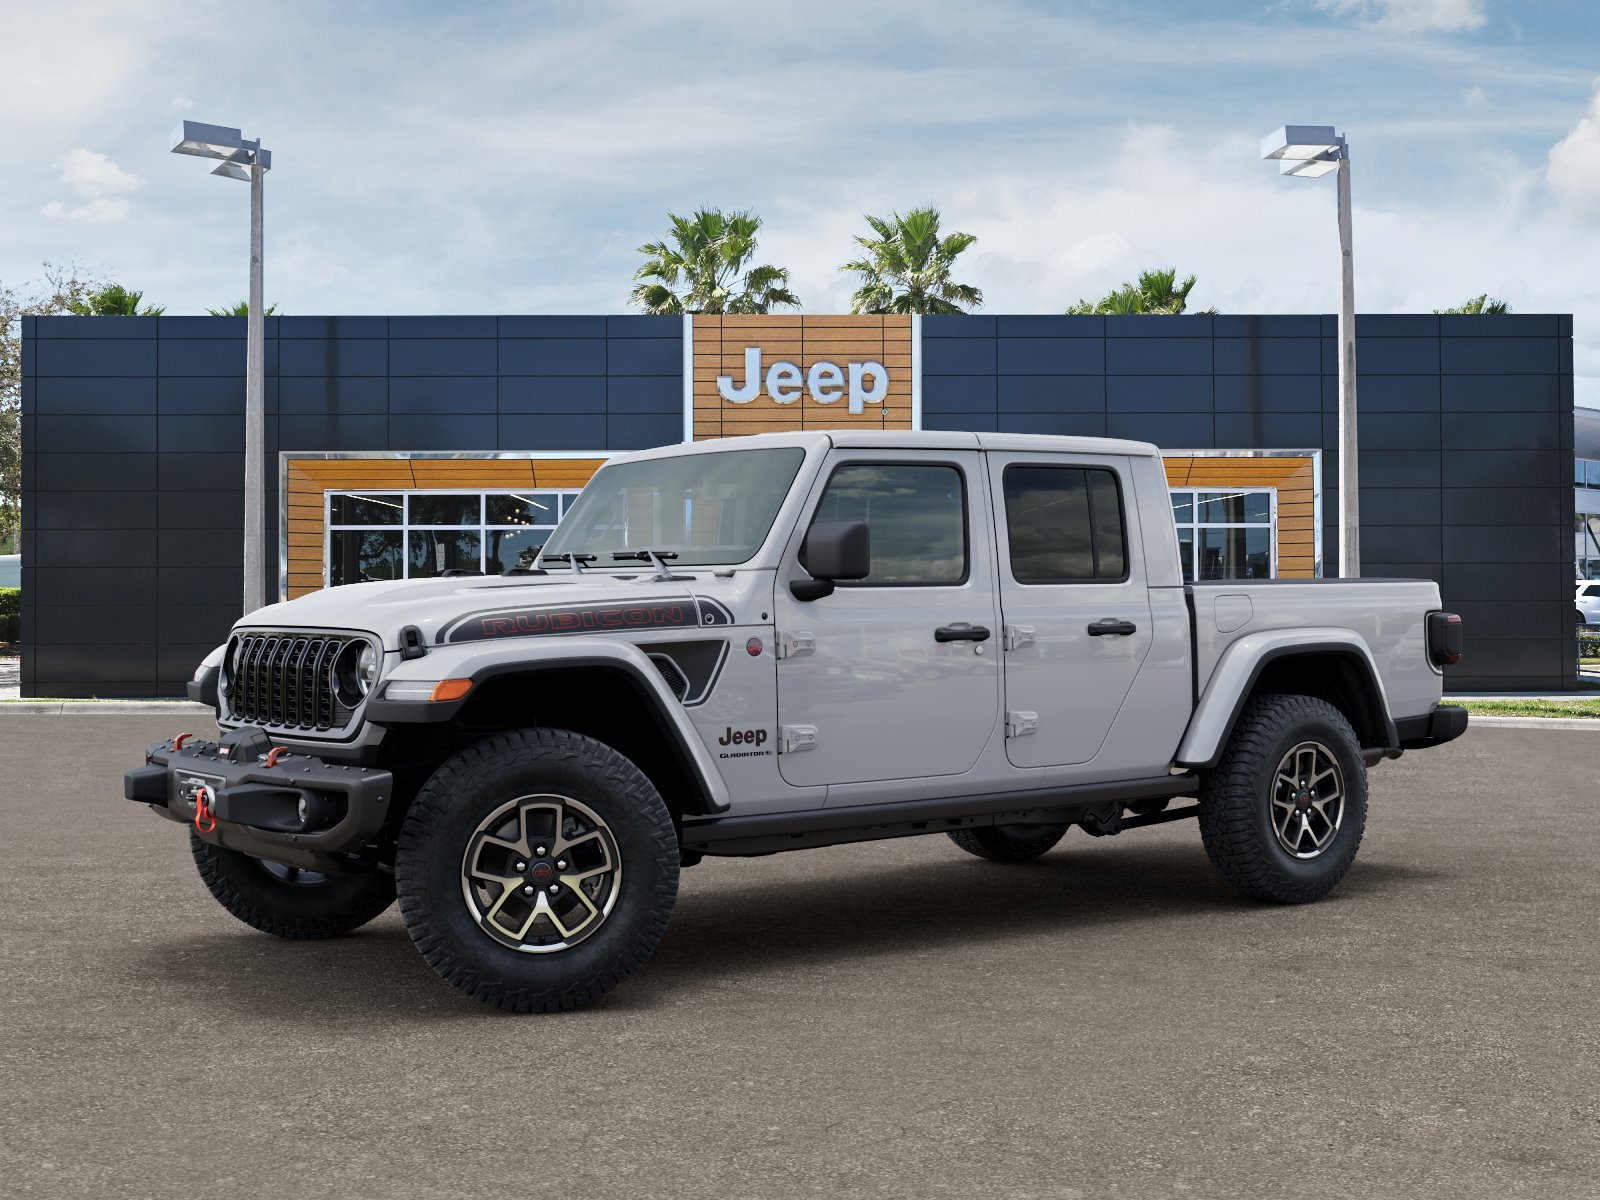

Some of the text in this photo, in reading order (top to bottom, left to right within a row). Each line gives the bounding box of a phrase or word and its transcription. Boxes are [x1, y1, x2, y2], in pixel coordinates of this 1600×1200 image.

[716, 347, 889, 414] Jeep
[481, 606, 684, 636] RUBICON
[719, 727, 767, 747] Jeep
